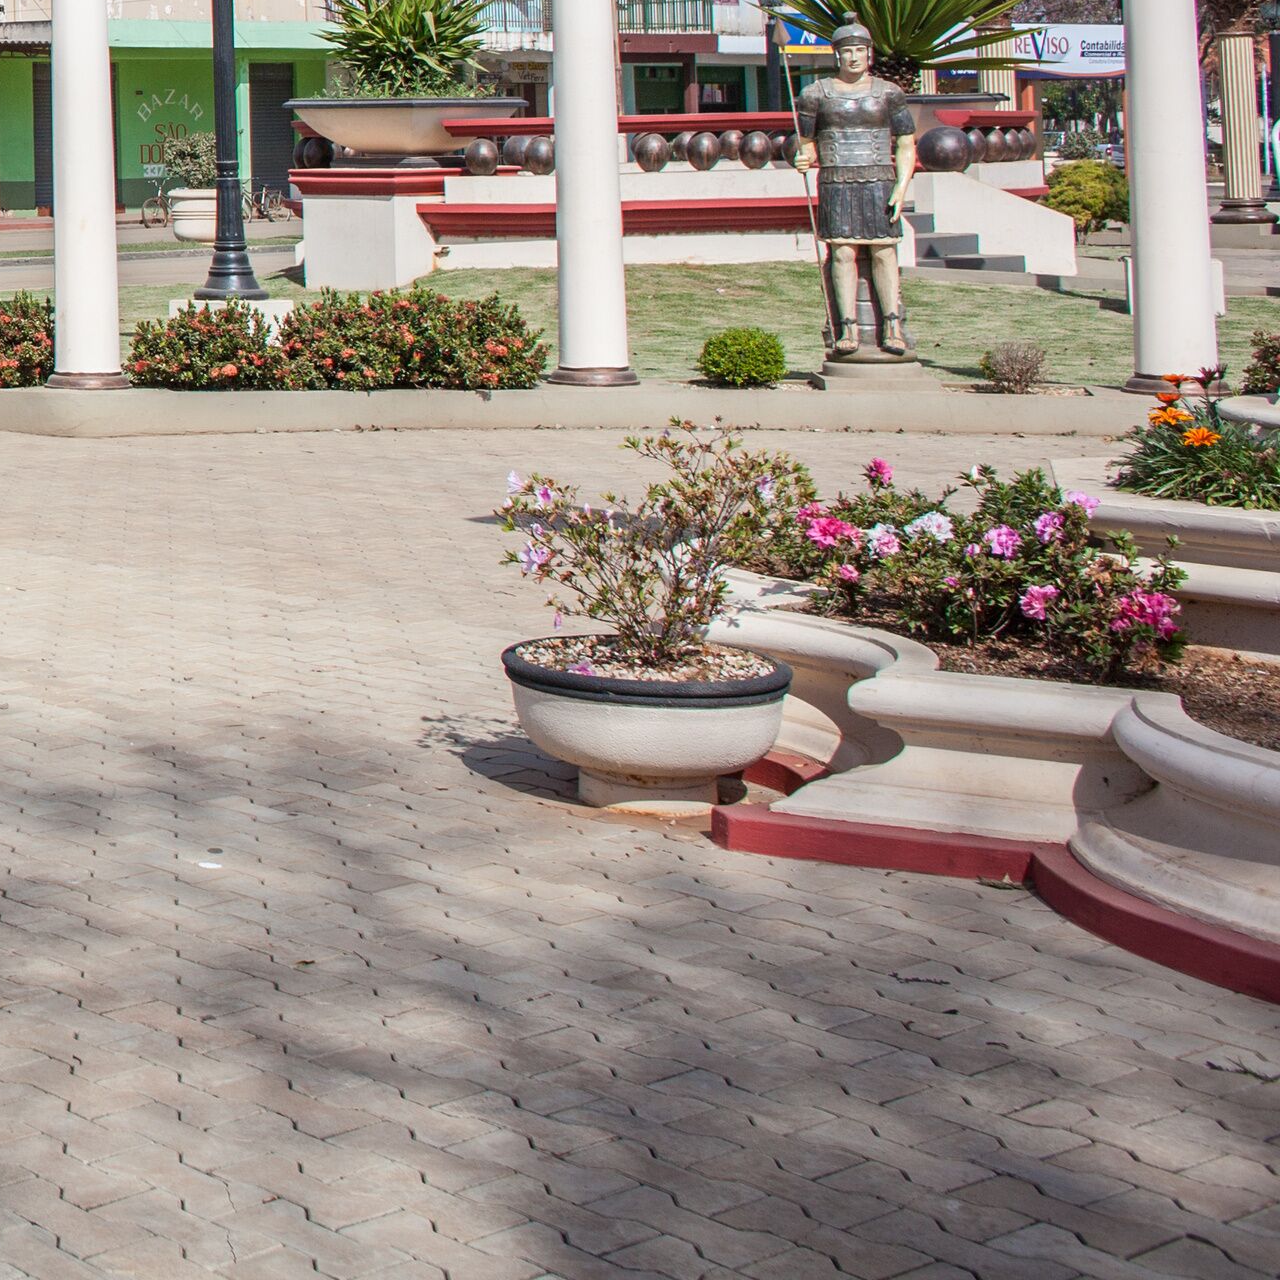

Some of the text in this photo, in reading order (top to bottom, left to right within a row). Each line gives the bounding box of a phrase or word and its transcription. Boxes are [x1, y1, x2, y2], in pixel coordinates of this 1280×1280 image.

[1014, 28, 1069, 62] REVISO
[1080, 39, 1125, 51] Contabilida
[137, 88, 204, 122] BAZAR
[154, 121, 188, 144] SÃO
